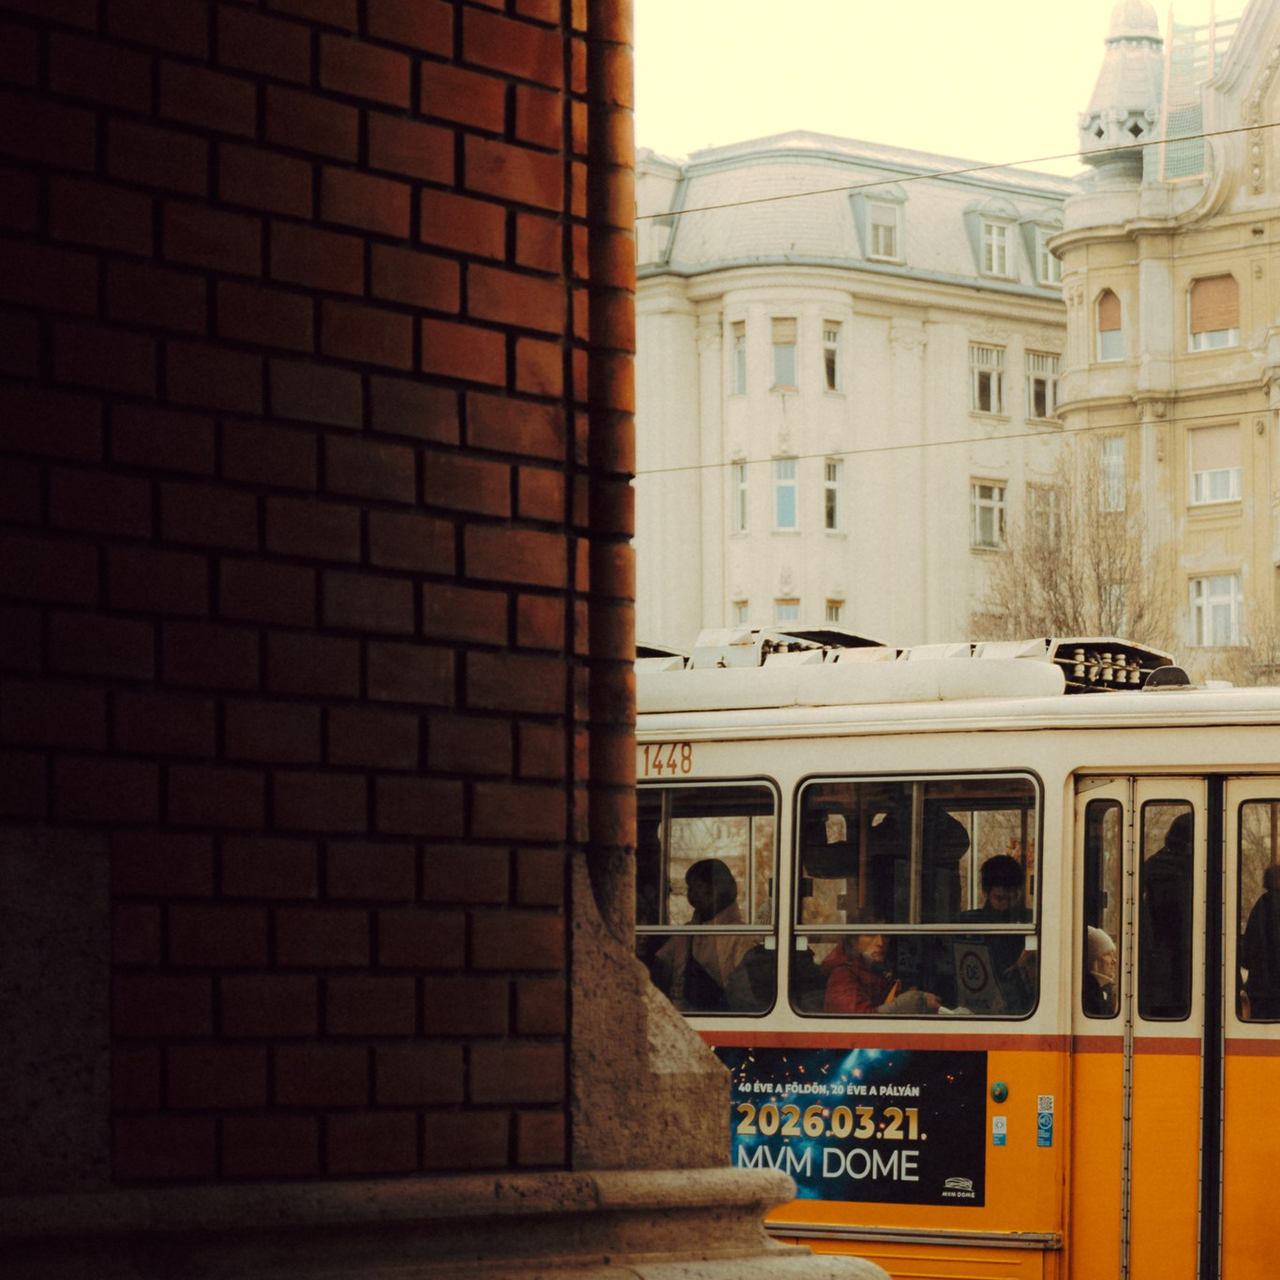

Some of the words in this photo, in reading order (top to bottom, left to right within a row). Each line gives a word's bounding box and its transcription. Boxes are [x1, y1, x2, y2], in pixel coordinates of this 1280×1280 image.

[643, 742, 693, 776] 1448
[738, 1082, 752, 1094] 40
[753, 1080, 773, 1094] ÉVE
[774, 1084, 783, 1094] A
[785, 1082, 830, 1096] FÖLDÖN,
[831, 1085, 844, 1095] 20
[846, 1082, 867, 1096] ÉVE
[868, 1085, 878, 1096] A
[879, 1083, 920, 1097] PÁLYÁN
[736, 1102, 928, 1141] 2026.03.21.
[737, 1143, 812, 1178] MVM
[822, 1147, 920, 1182] DOME
[957, 1191, 976, 1199] DOME
